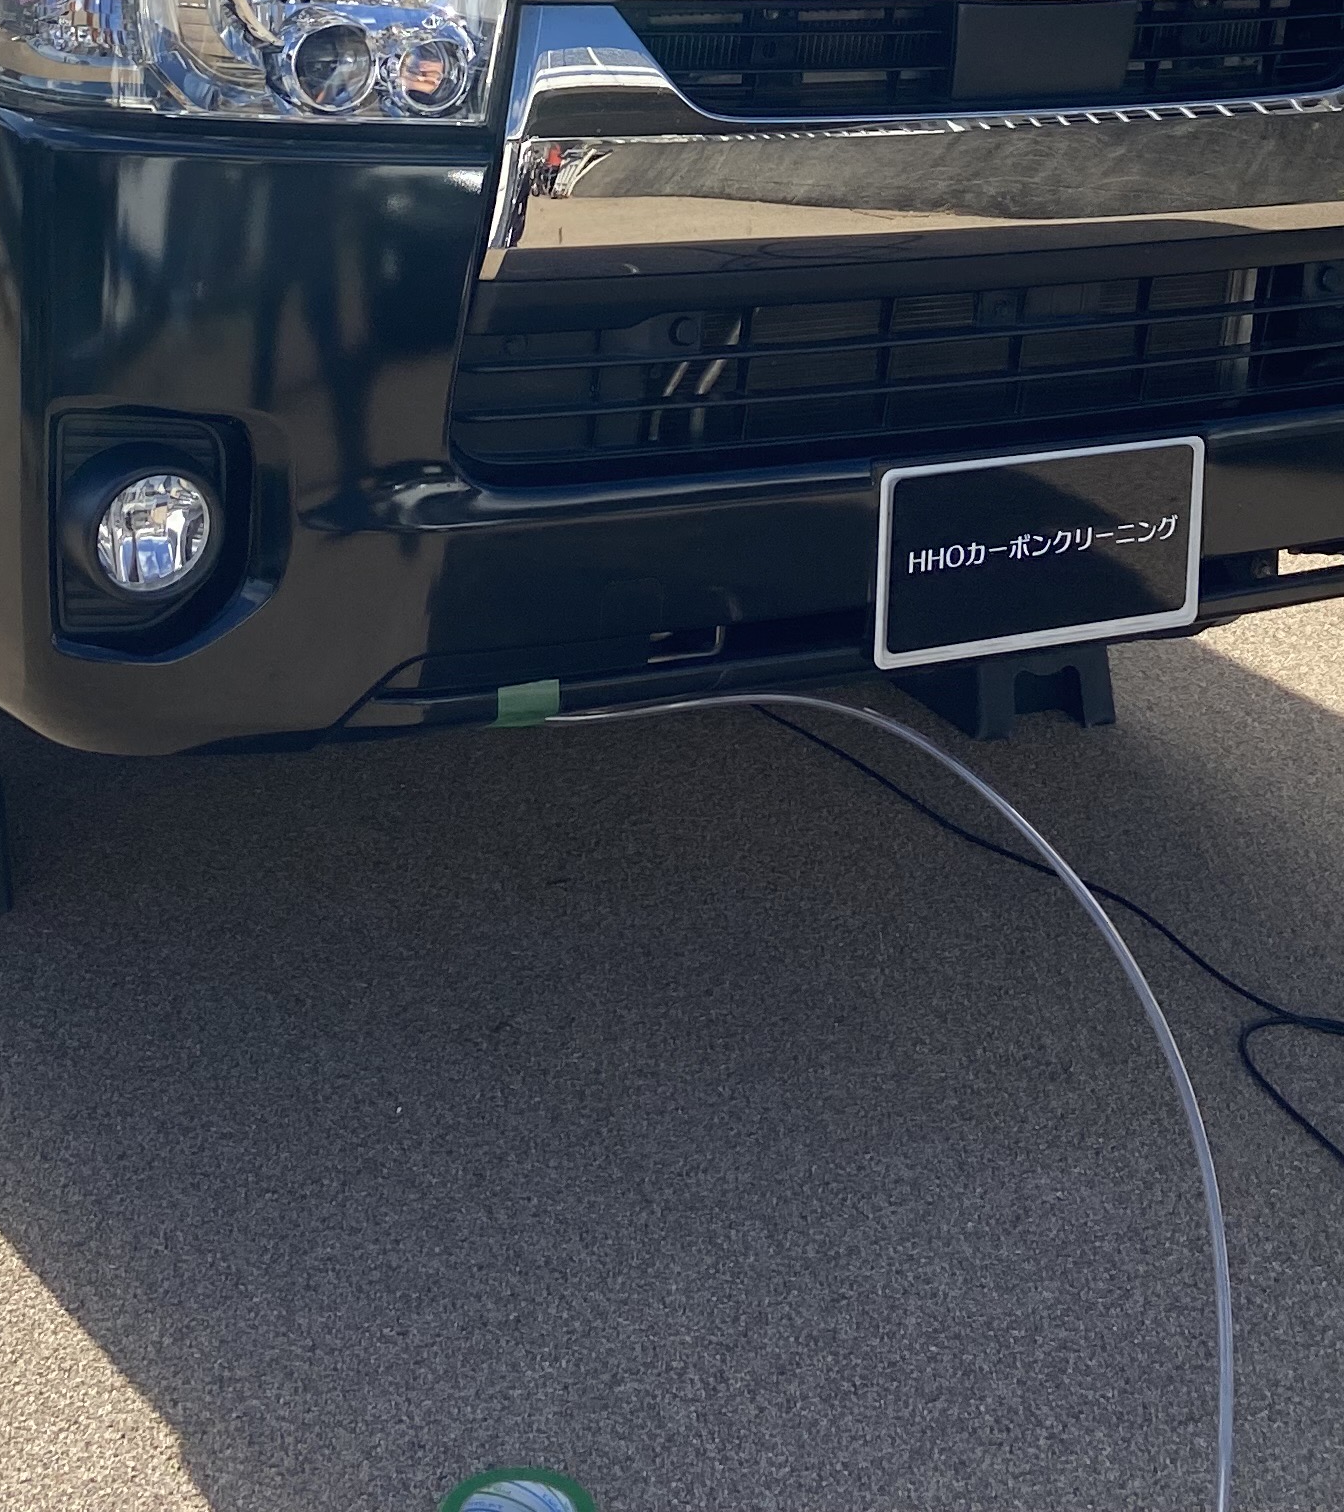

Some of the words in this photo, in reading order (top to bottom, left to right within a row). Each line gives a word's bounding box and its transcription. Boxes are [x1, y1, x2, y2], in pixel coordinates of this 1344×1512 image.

[908, 514, 1178, 574] HHOカーボンクリーニング
